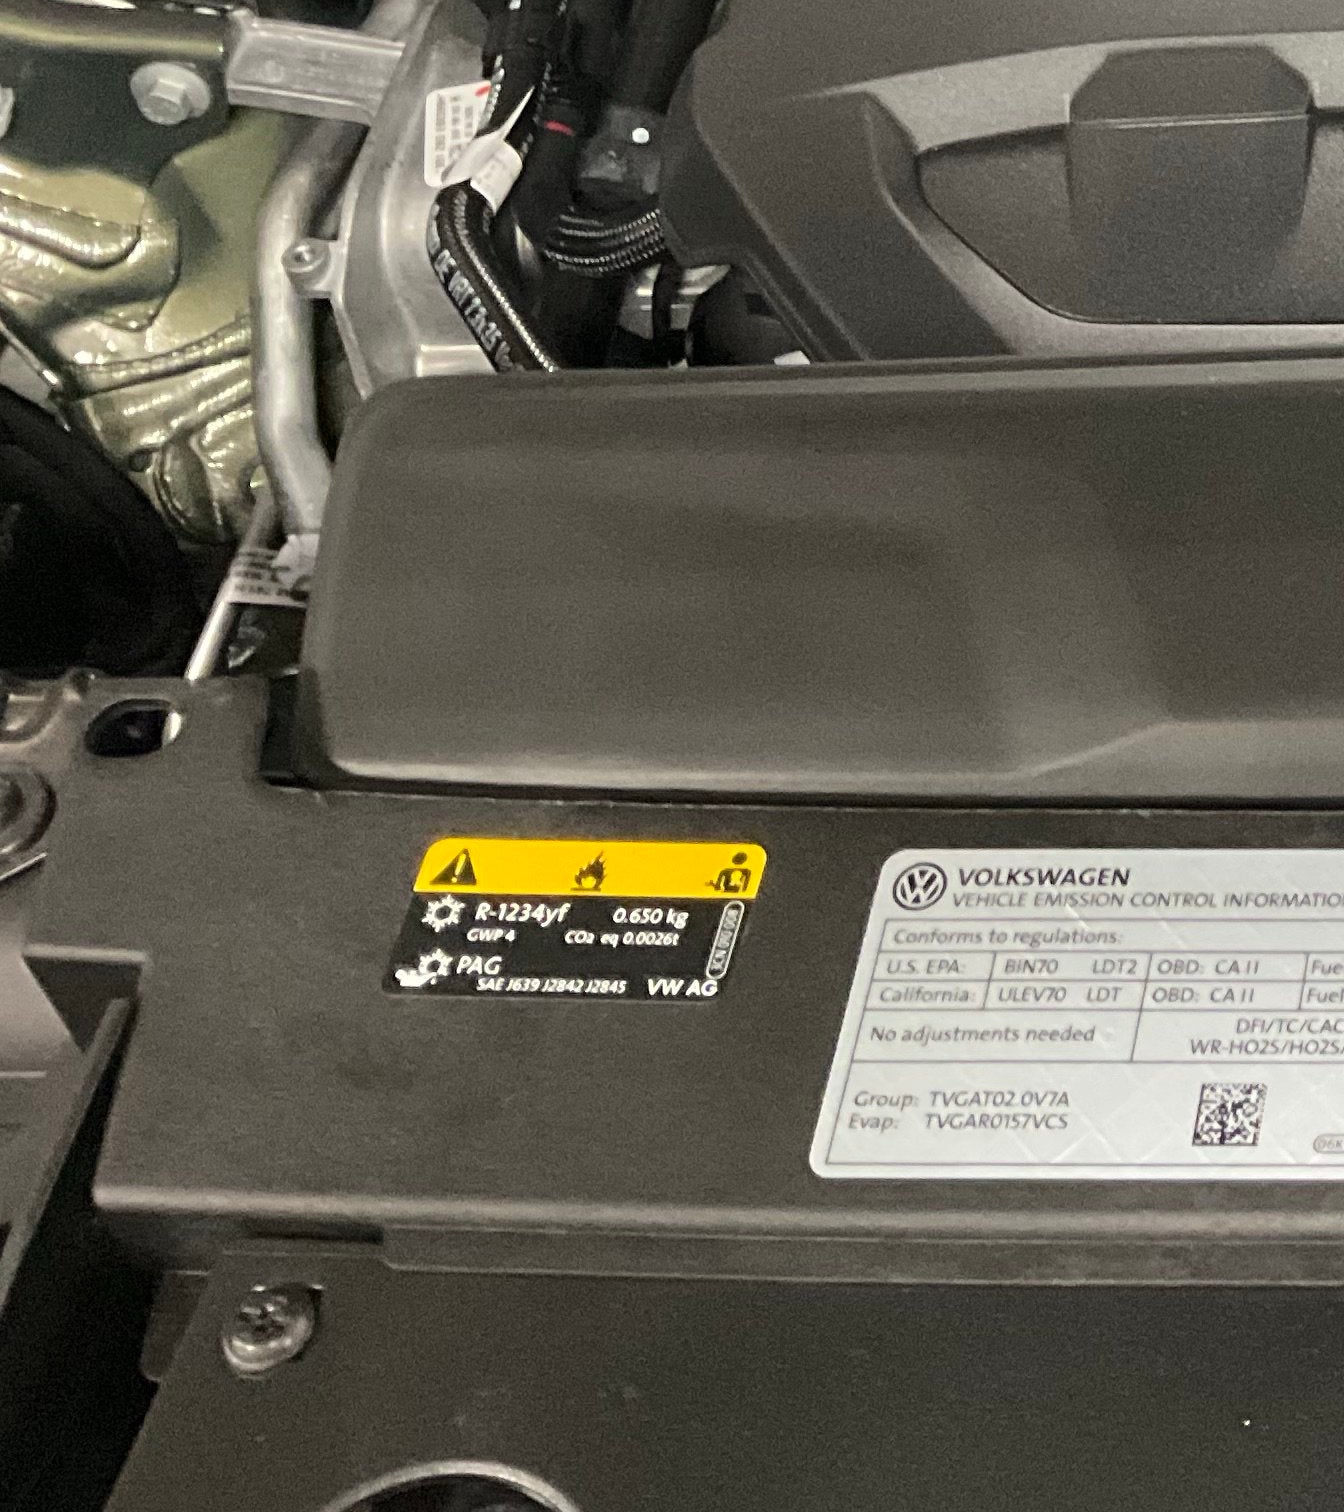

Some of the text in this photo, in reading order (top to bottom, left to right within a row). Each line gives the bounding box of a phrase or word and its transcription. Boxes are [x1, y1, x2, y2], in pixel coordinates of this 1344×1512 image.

[958, 867, 1131, 887] VOLKSWAGEN
[953, 893, 1027, 908] VEHICLE
[1034, 892, 1124, 907] EMISSION
[1131, 893, 1217, 908] CONTROL
[474, 903, 689, 928] R-1234yf 0.650 kg
[467, 929, 515, 942] GWP 4
[601, 933, 618, 948] eq
[623, 933, 679, 946] 0.0026t
[894, 928, 1121, 948] Conforms to regulations:
[456, 956, 502, 974] PAG
[1005, 959, 1137, 974] BIN70 LDT2
[477, 978, 504, 992] SAE
[647, 979, 718, 996] VW AG
[999, 988, 1122, 1002] ULEV70 LDT
[870, 1026, 1095, 1046] No adjustments needed
[854, 1092, 918, 1112] Group:
[849, 1114, 898, 1134] Evap:
